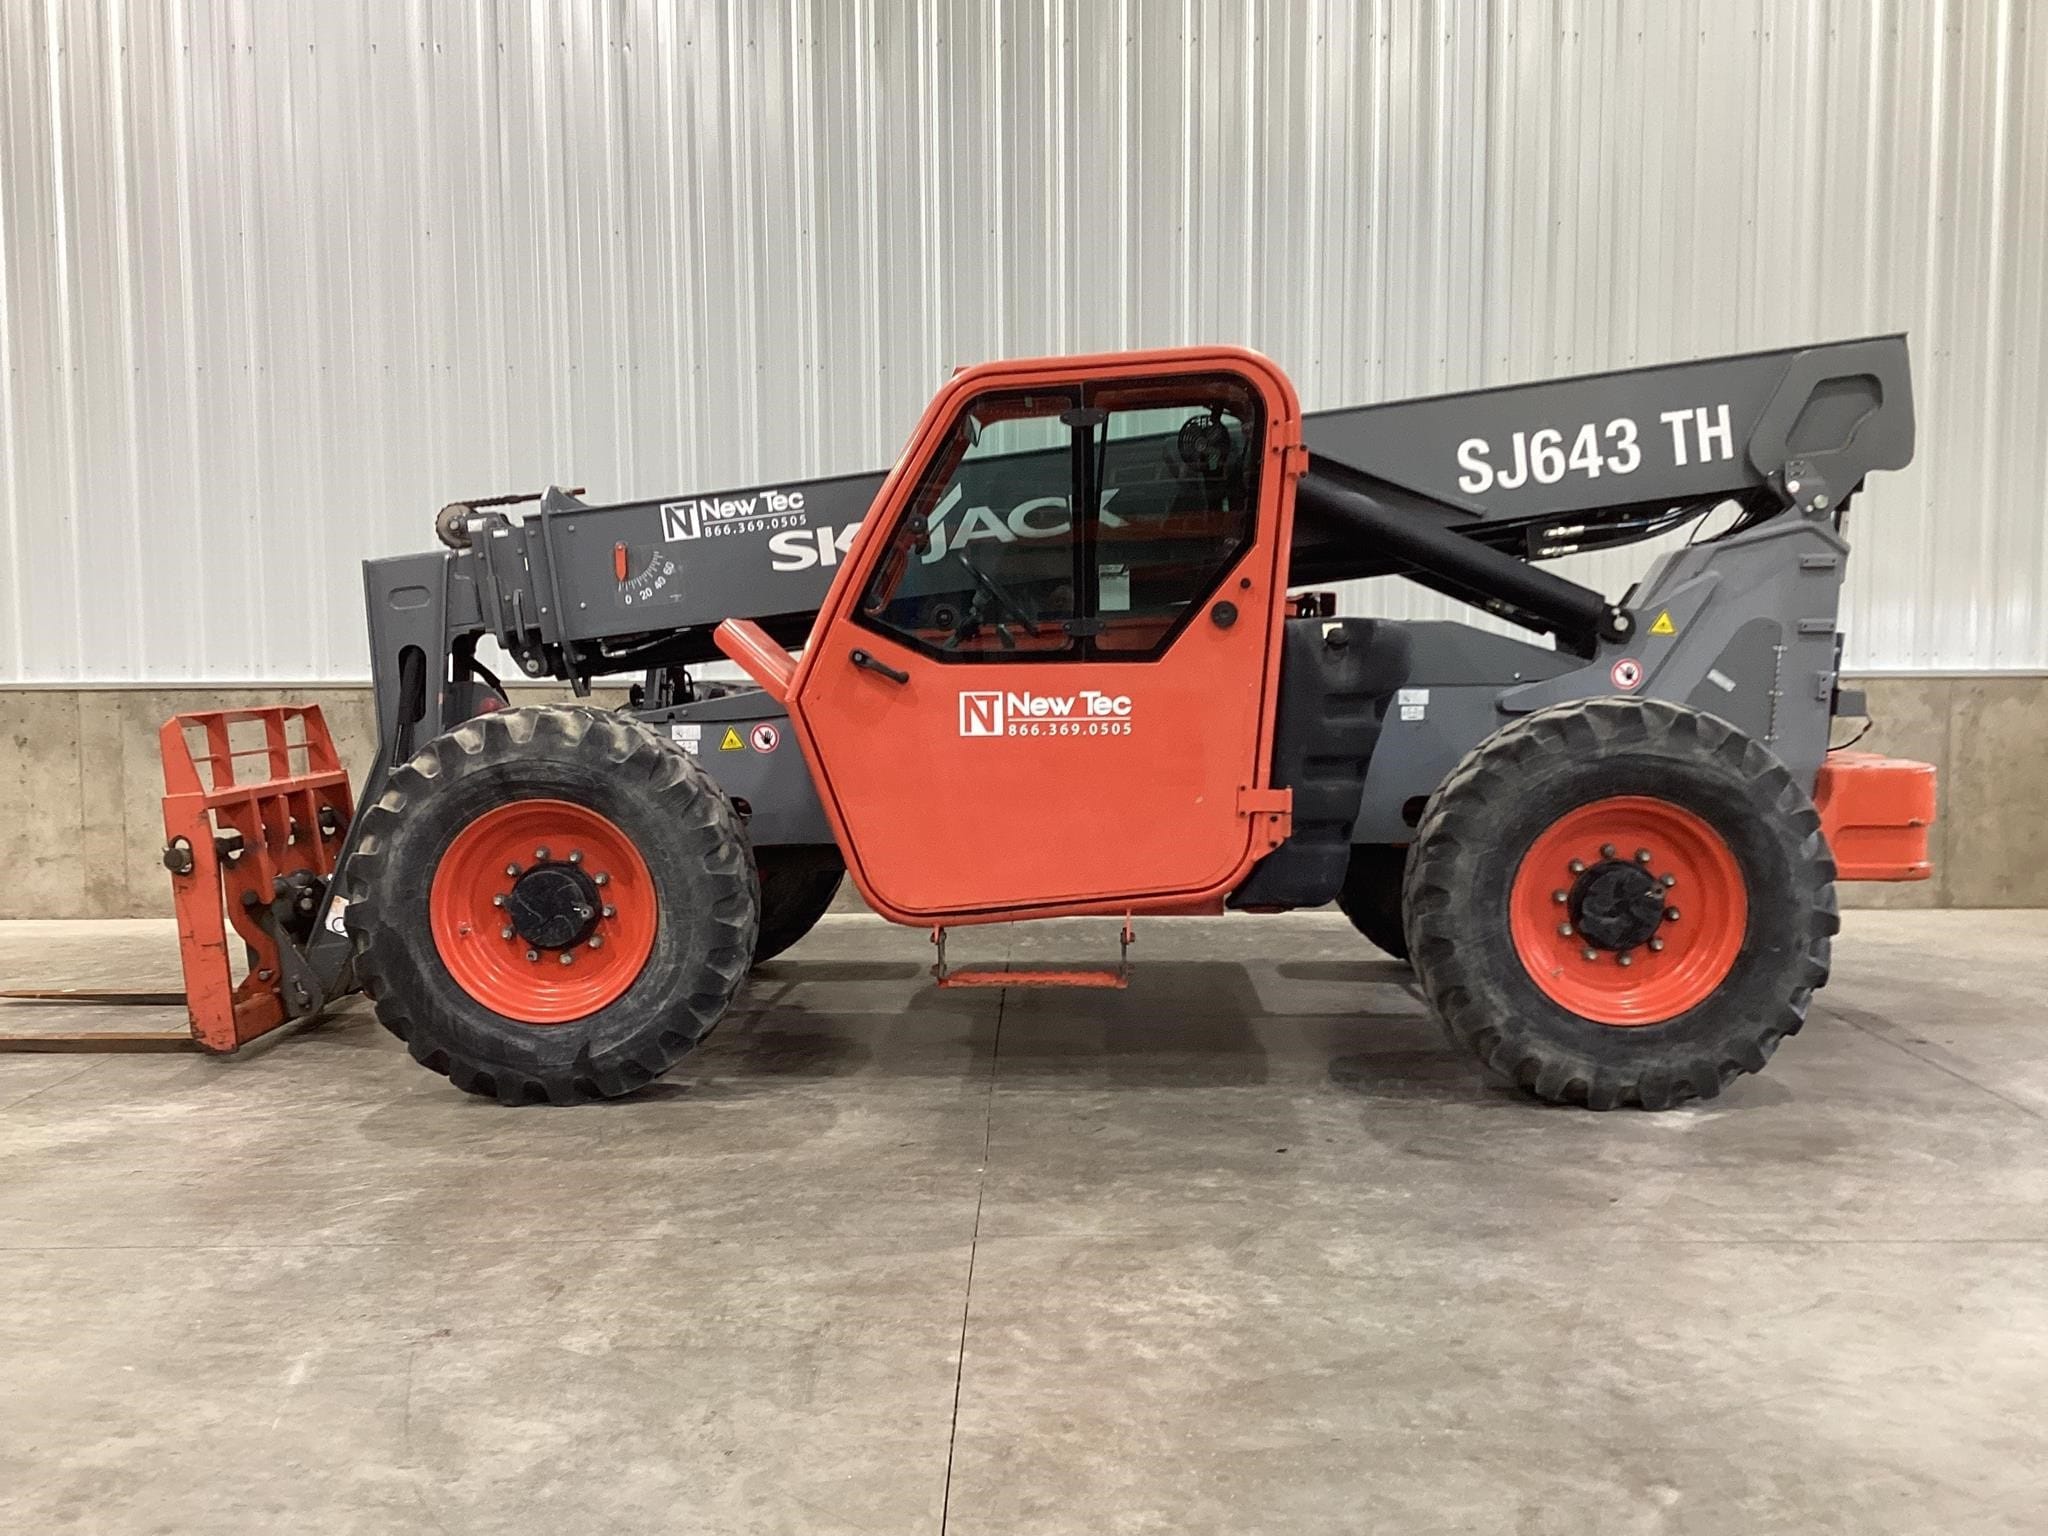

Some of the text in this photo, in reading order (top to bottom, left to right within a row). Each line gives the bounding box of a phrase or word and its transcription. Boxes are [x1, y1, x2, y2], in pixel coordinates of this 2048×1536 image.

[1457, 404, 1734, 494] SJ643 TH
[700, 490, 804, 520] New Tec
[704, 515, 807, 538] 866.369.0505
[639, 587, 653, 601] 20
[1007, 691, 1132, 717] New Tec
[1008, 723, 1132, 736] 866.369.0505
